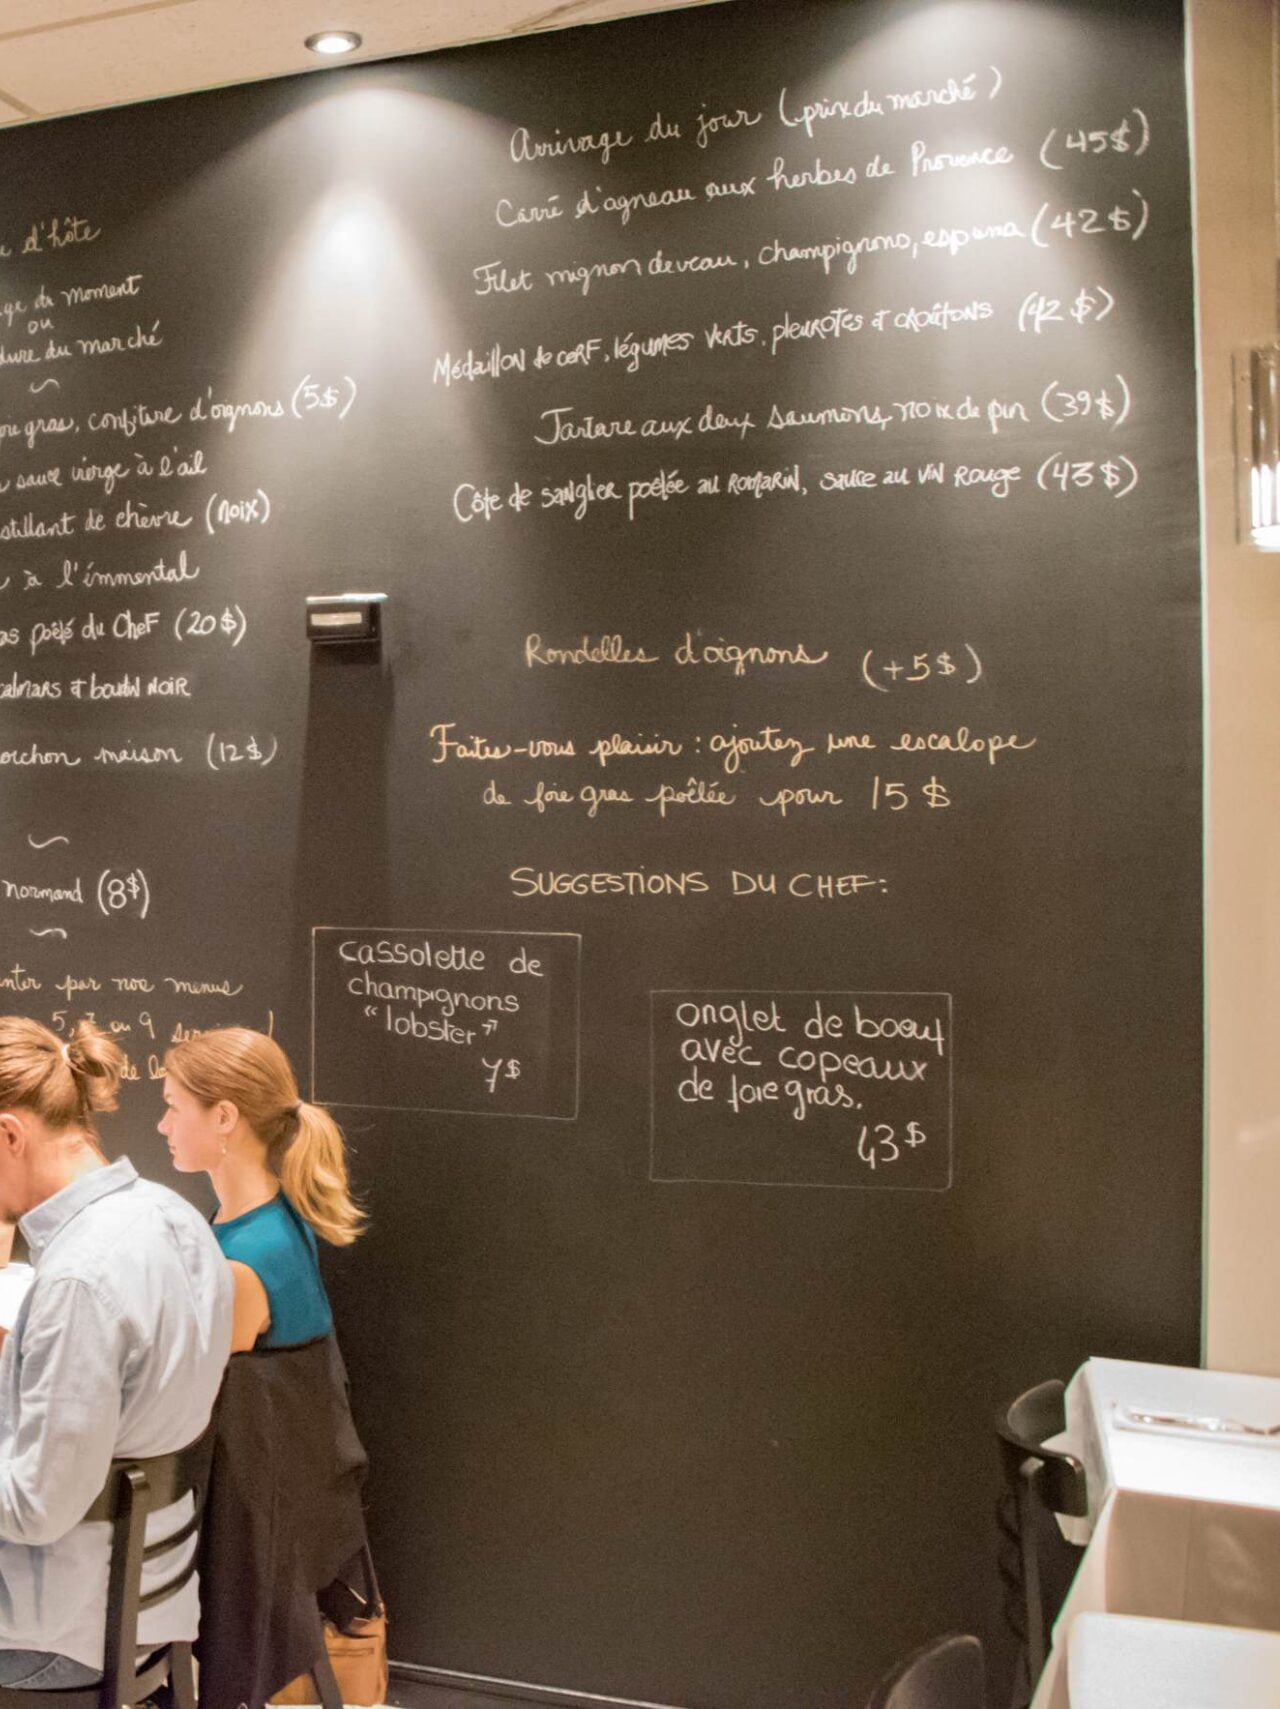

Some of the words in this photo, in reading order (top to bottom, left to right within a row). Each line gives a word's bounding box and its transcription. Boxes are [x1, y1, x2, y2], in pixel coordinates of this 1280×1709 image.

[510, 127, 633, 165] Arrivage
[645, 112, 681, 144] du
[696, 103, 763, 148] jour
[854, 91, 884, 118] du
[496, 194, 564, 228] Carré
[574, 186, 696, 226] d'agneau
[706, 176, 757, 202] aux
[767, 156, 857, 189] herbes
[866, 154, 895, 178] de
[911, 141, 1015, 177] Provence
[1039, 108, 1151, 171] (45$)
[21, 217, 102, 255] d'hôte
[473, 260, 533, 296] Filet
[545, 259, 642, 296] mignon
[28, 316, 55, 334] ou
[45, 339, 72, 362] du
[78, 320, 163, 355] marché
[533, 345, 551, 369] de
[24, 417, 80, 449] gras,
[88, 405, 181, 437] confiture
[291, 374, 356, 420] (5$)
[534, 407, 636, 445] Tartare
[640, 416, 693, 440] aux
[699, 404, 756, 440] deux
[957, 396, 980, 420] de
[988, 400, 1030, 435] pin
[1041, 373, 1131, 427] (39$)
[17, 467, 63, 489] sauce
[136, 452, 153, 476] à
[159, 445, 208, 476] l'ail
[453, 483, 503, 522] Côte
[508, 482, 533, 512] de
[697, 478, 720, 495] au
[883, 468, 911, 485] au
[1037, 451, 1139, 499] (43$)
[85, 509, 106, 531] de
[115, 500, 193, 528] chèvre
[23, 569, 42, 590] à
[81, 613, 105, 640] du
[175, 603, 247, 647] (20$)
[526, 633, 659, 668] Rondelles
[675, 628, 828, 676] d'oignons
[94, 739, 183, 764] maison
[207, 732, 278, 771] (12$)
[429, 723, 577, 764] Faites-vous
[710, 723, 815, 773] ajoutez
[827, 733, 877, 753] une
[890, 726, 1037, 765] escalope
[482, 779, 512, 805] de
[524, 781, 573, 813] foie
[580, 785, 634, 817] gras
[645, 777, 736, 817] poêlée
[759, 788, 844, 817] pour
[98, 868, 150, 920] (8$)
[510, 865, 710, 897] SUGGESTIONS
[731, 871, 776, 894] DU
[509, 947, 544, 977] de
[55, 975, 102, 1001] par
[164, 977, 244, 996] menus
[348, 970, 520, 1017] champignons
[110, 1021, 131, 1033] ou
[139, 1011, 156, 1039] 9
[804, 1000, 844, 1039] de
[681, 1038, 762, 1065] avec
[778, 1045, 928, 1083] copeaux
[678, 1065, 714, 1102] de
[728, 1074, 779, 1113] foie
